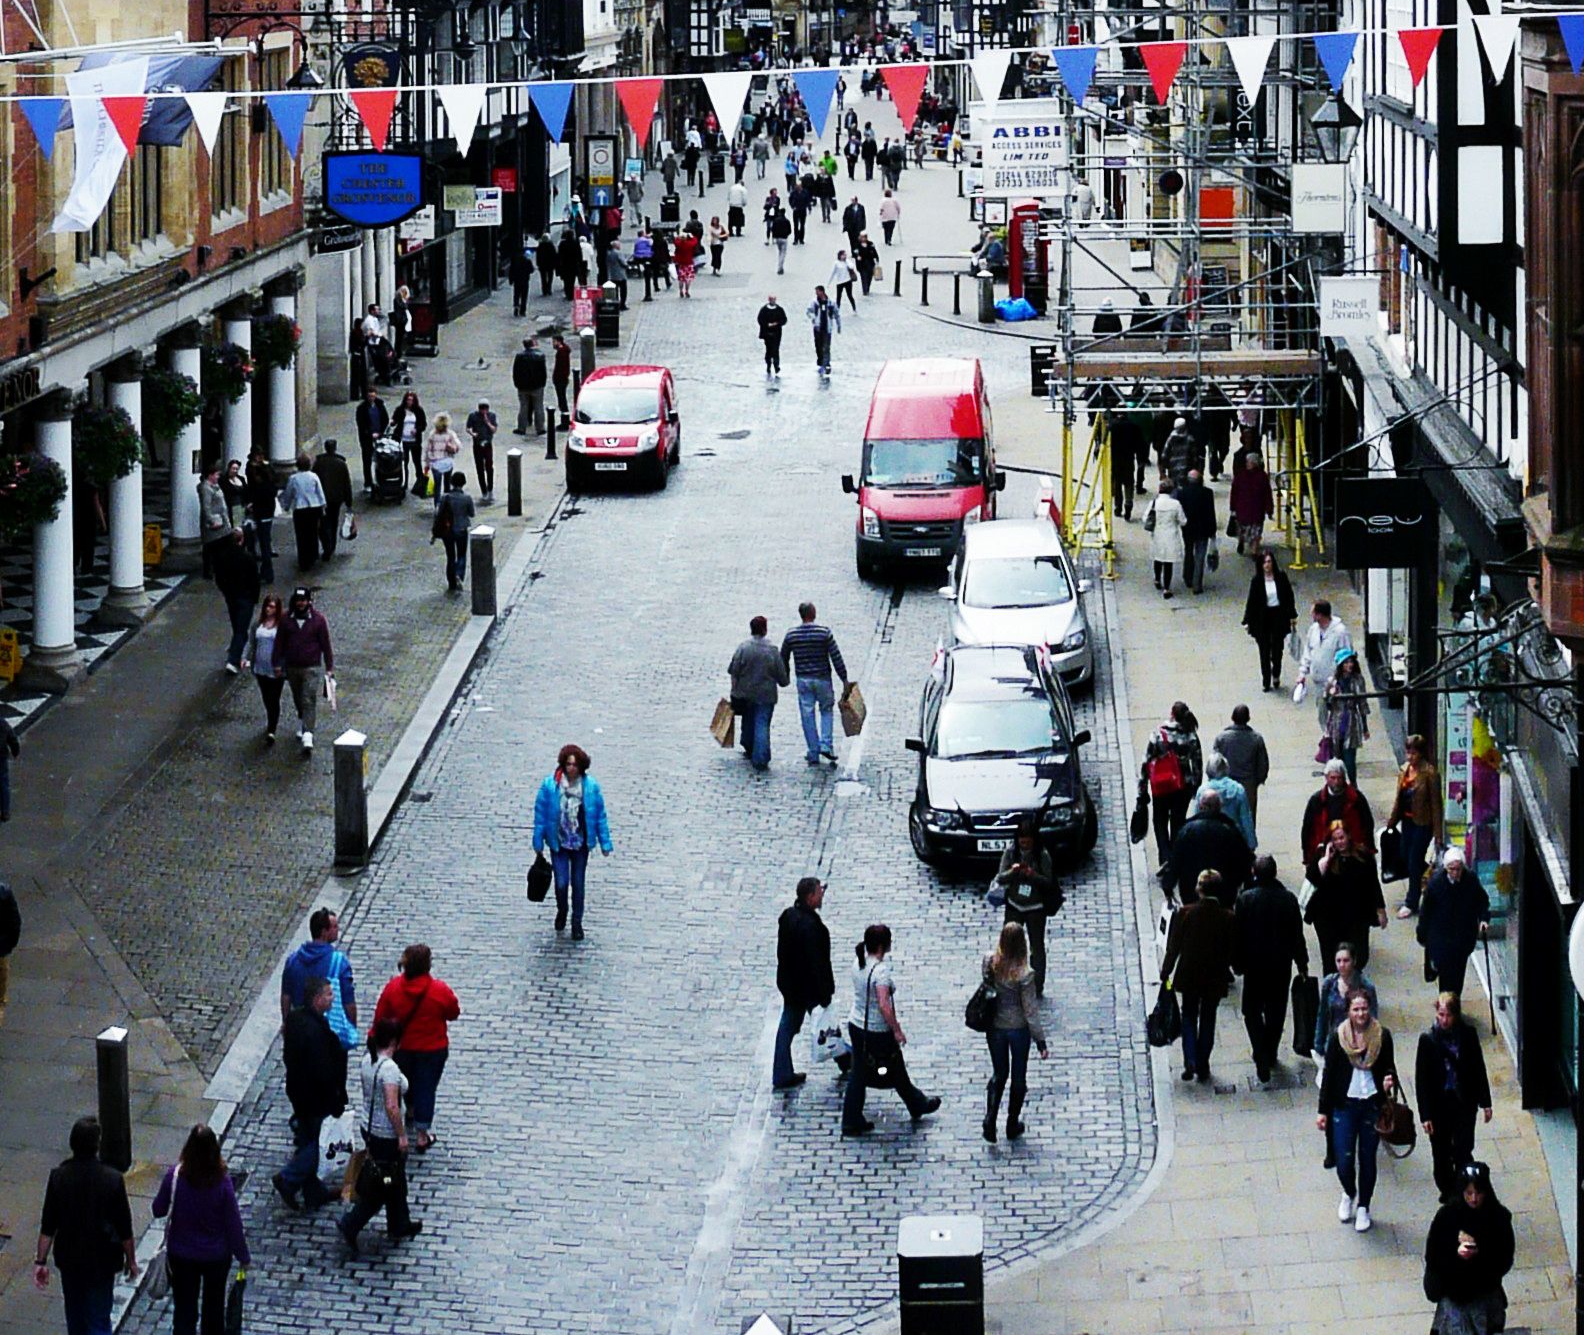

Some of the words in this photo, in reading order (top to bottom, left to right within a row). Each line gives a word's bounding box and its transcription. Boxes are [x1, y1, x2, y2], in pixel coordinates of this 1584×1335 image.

[993, 125, 1061, 138] ABBI
[1025, 141, 1062, 149] SERVICES
[1003, 152, 1049, 161] LIMTED
[360, 163, 387, 174] THE
[342, 177, 405, 188] CHESTER
[333, 193, 415, 204] GROSVENOR
[1332, 297, 1367, 309] Russell
